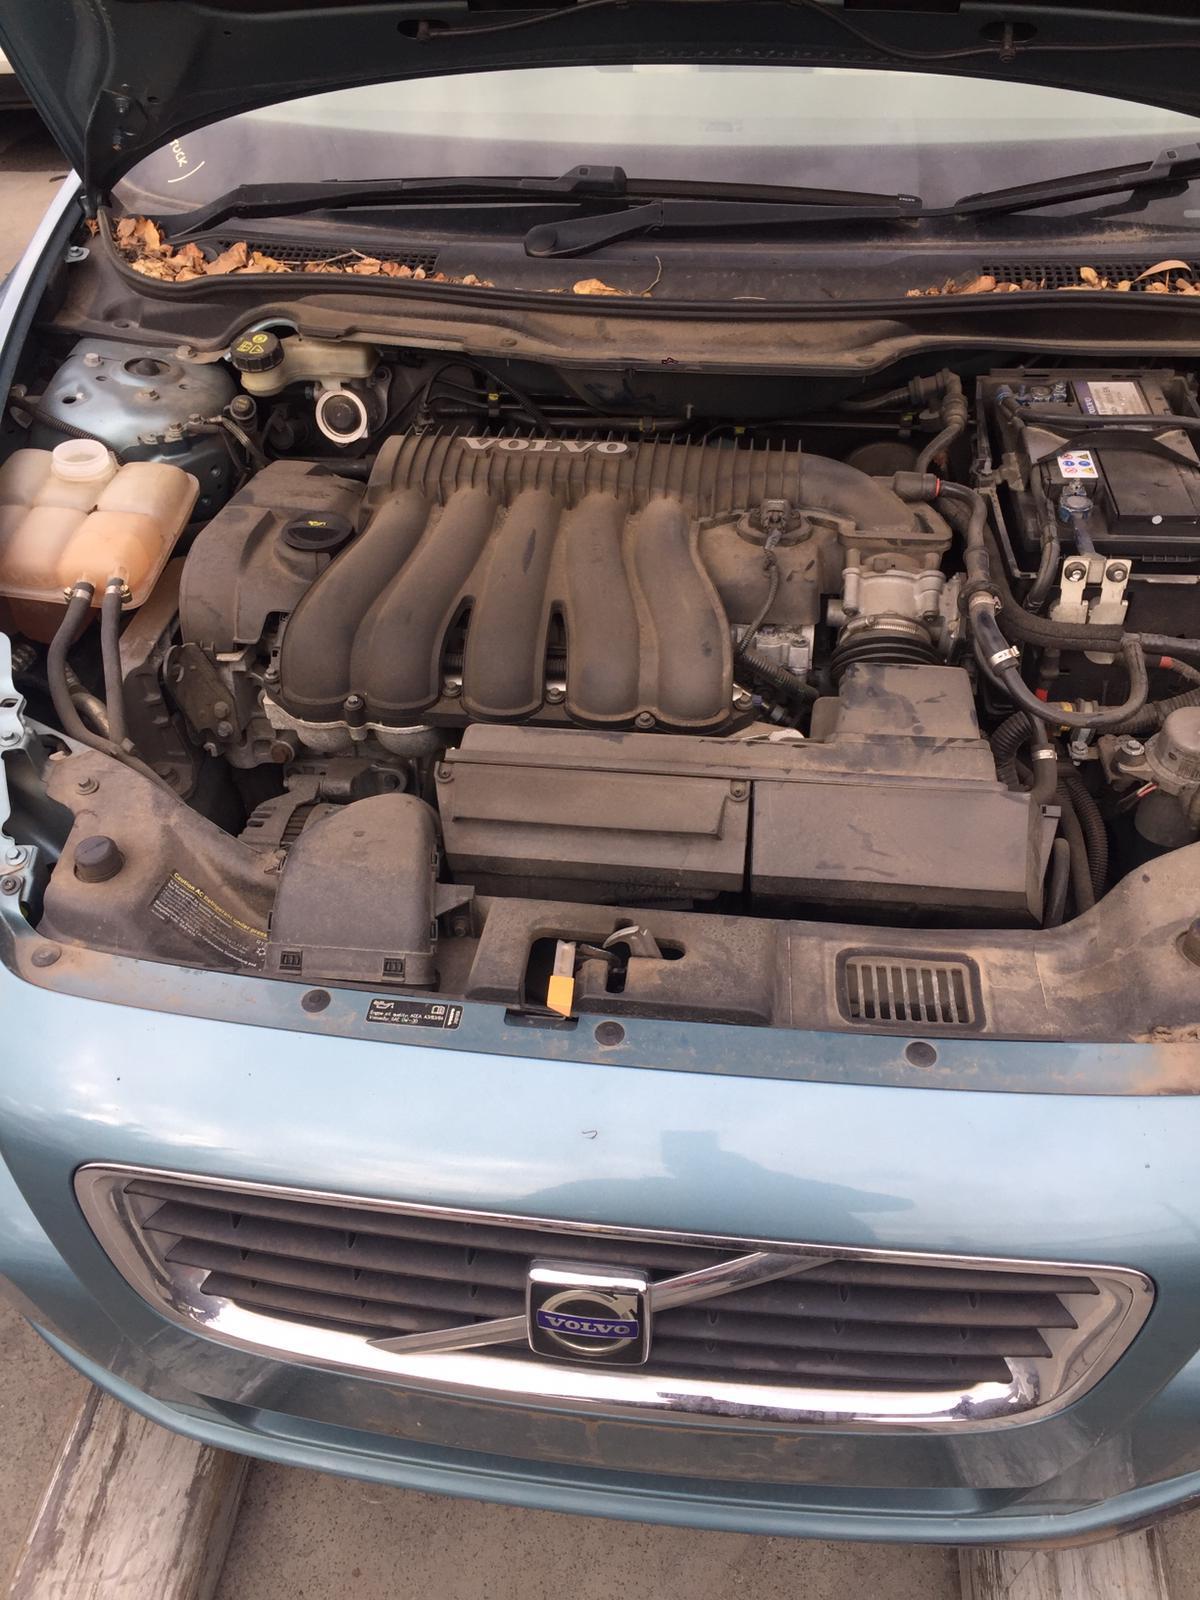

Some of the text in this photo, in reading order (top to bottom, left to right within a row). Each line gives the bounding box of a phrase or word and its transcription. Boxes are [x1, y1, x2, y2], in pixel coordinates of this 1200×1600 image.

[459, 437, 628, 454] VOLVO
[174, 872, 195, 890] Caution
[195, 888, 205, 898] AC
[544, 1315, 630, 1334] VOLVO
